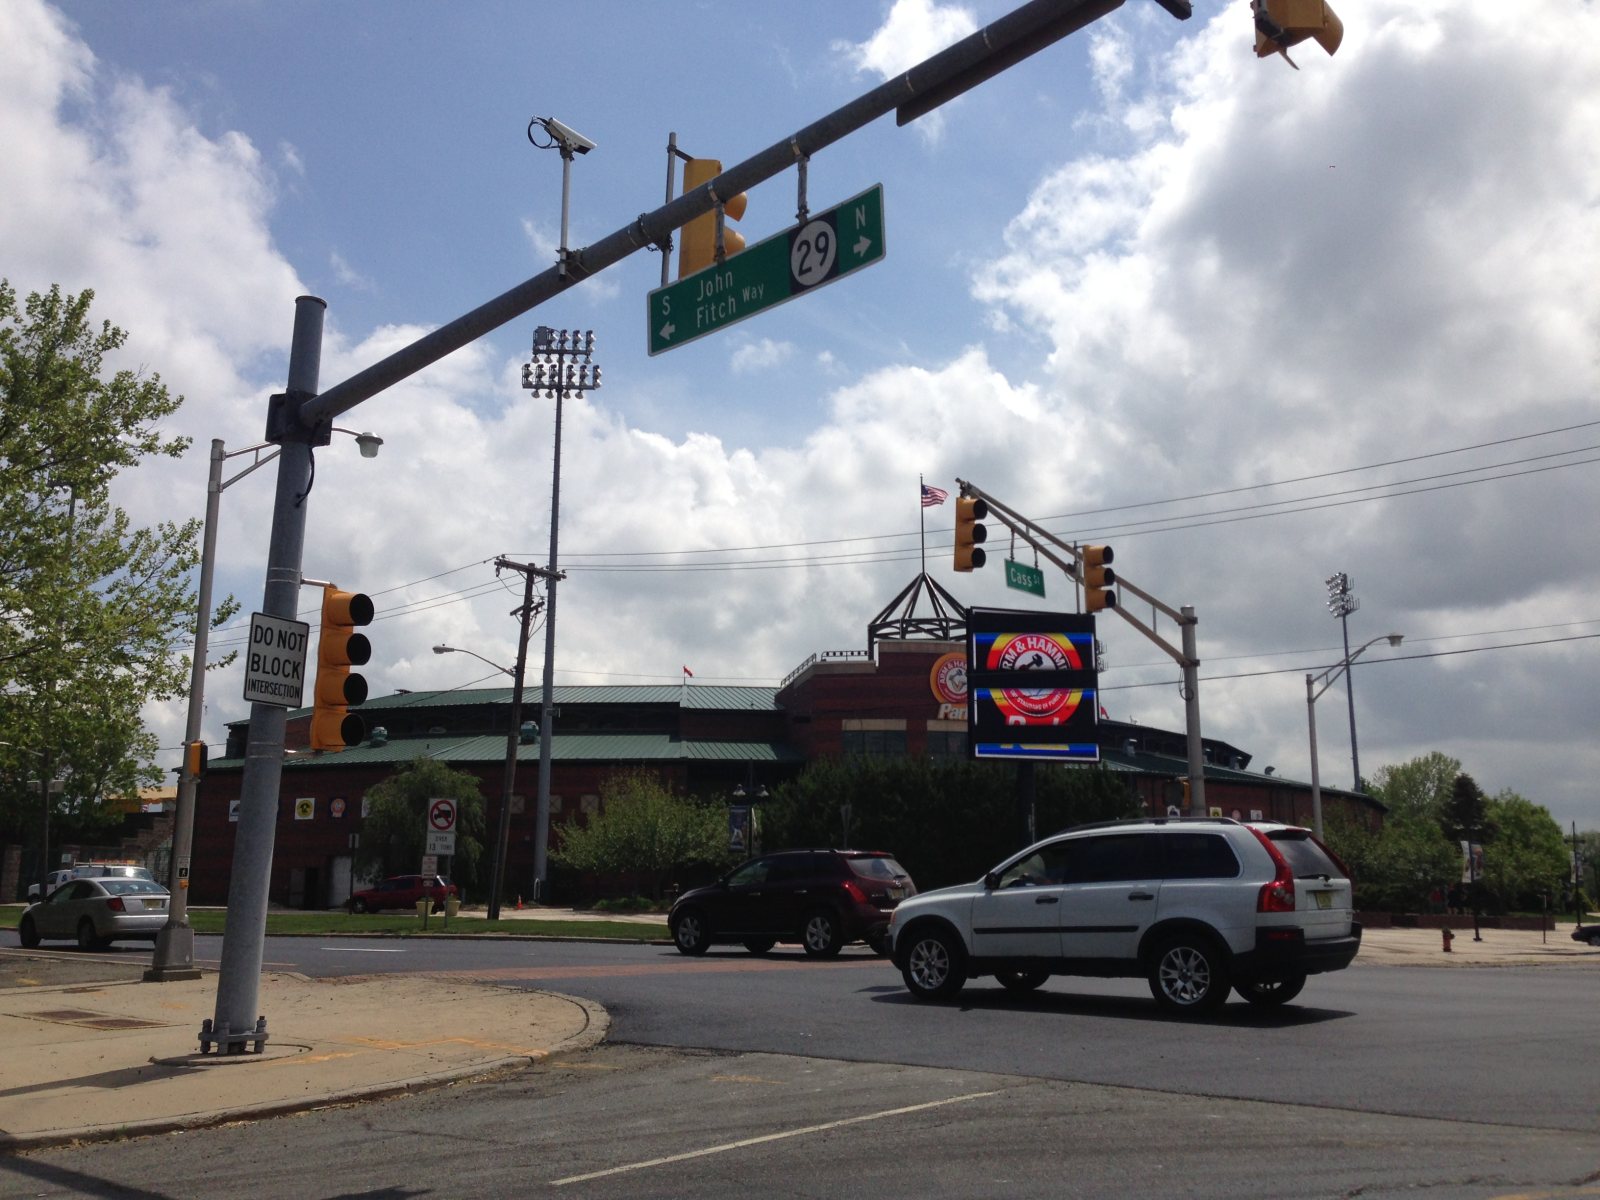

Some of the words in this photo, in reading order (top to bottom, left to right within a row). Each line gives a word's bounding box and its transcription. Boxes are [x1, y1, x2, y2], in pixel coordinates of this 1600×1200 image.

[855, 204, 867, 230] N
[796, 231, 830, 277] 29
[696, 271, 733, 302] John
[662, 295, 671, 316] S
[696, 295, 736, 329] Fitch
[742, 283, 764, 304] Way
[1010, 567, 1033, 588] Cass
[253, 625, 274, 646] DO
[277, 629, 305, 652] NOT
[250, 653, 302, 680] BLOCK
[1002, 648, 1018, 670] RM
[1015, 640, 1026, 653] &
[1026, 636, 1068, 670] HAMM
[247, 678, 301, 699] INTERSECTION
